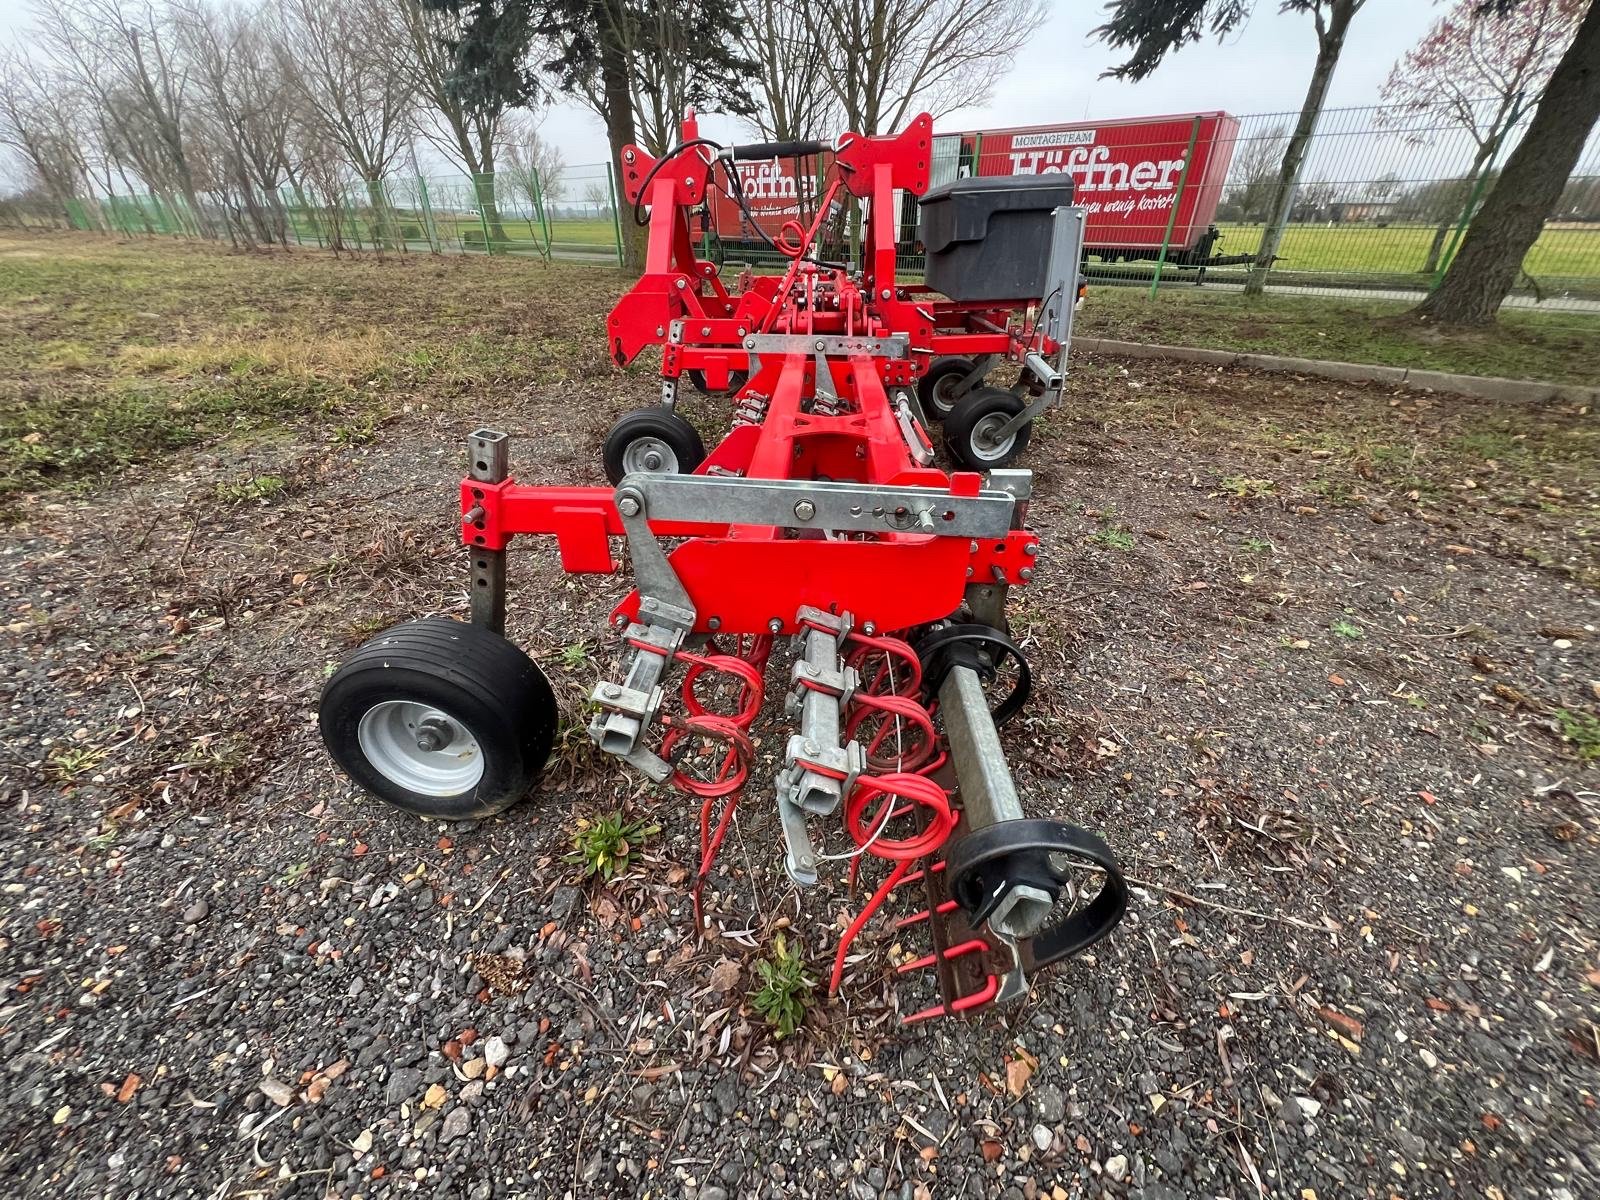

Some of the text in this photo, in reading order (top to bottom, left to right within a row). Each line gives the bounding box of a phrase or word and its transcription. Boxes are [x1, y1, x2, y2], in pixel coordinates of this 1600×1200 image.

[1015, 131, 1092, 147] MONTAGETEAM
[1103, 195, 1136, 219] wenig
[1136, 193, 1177, 211] kostet!
